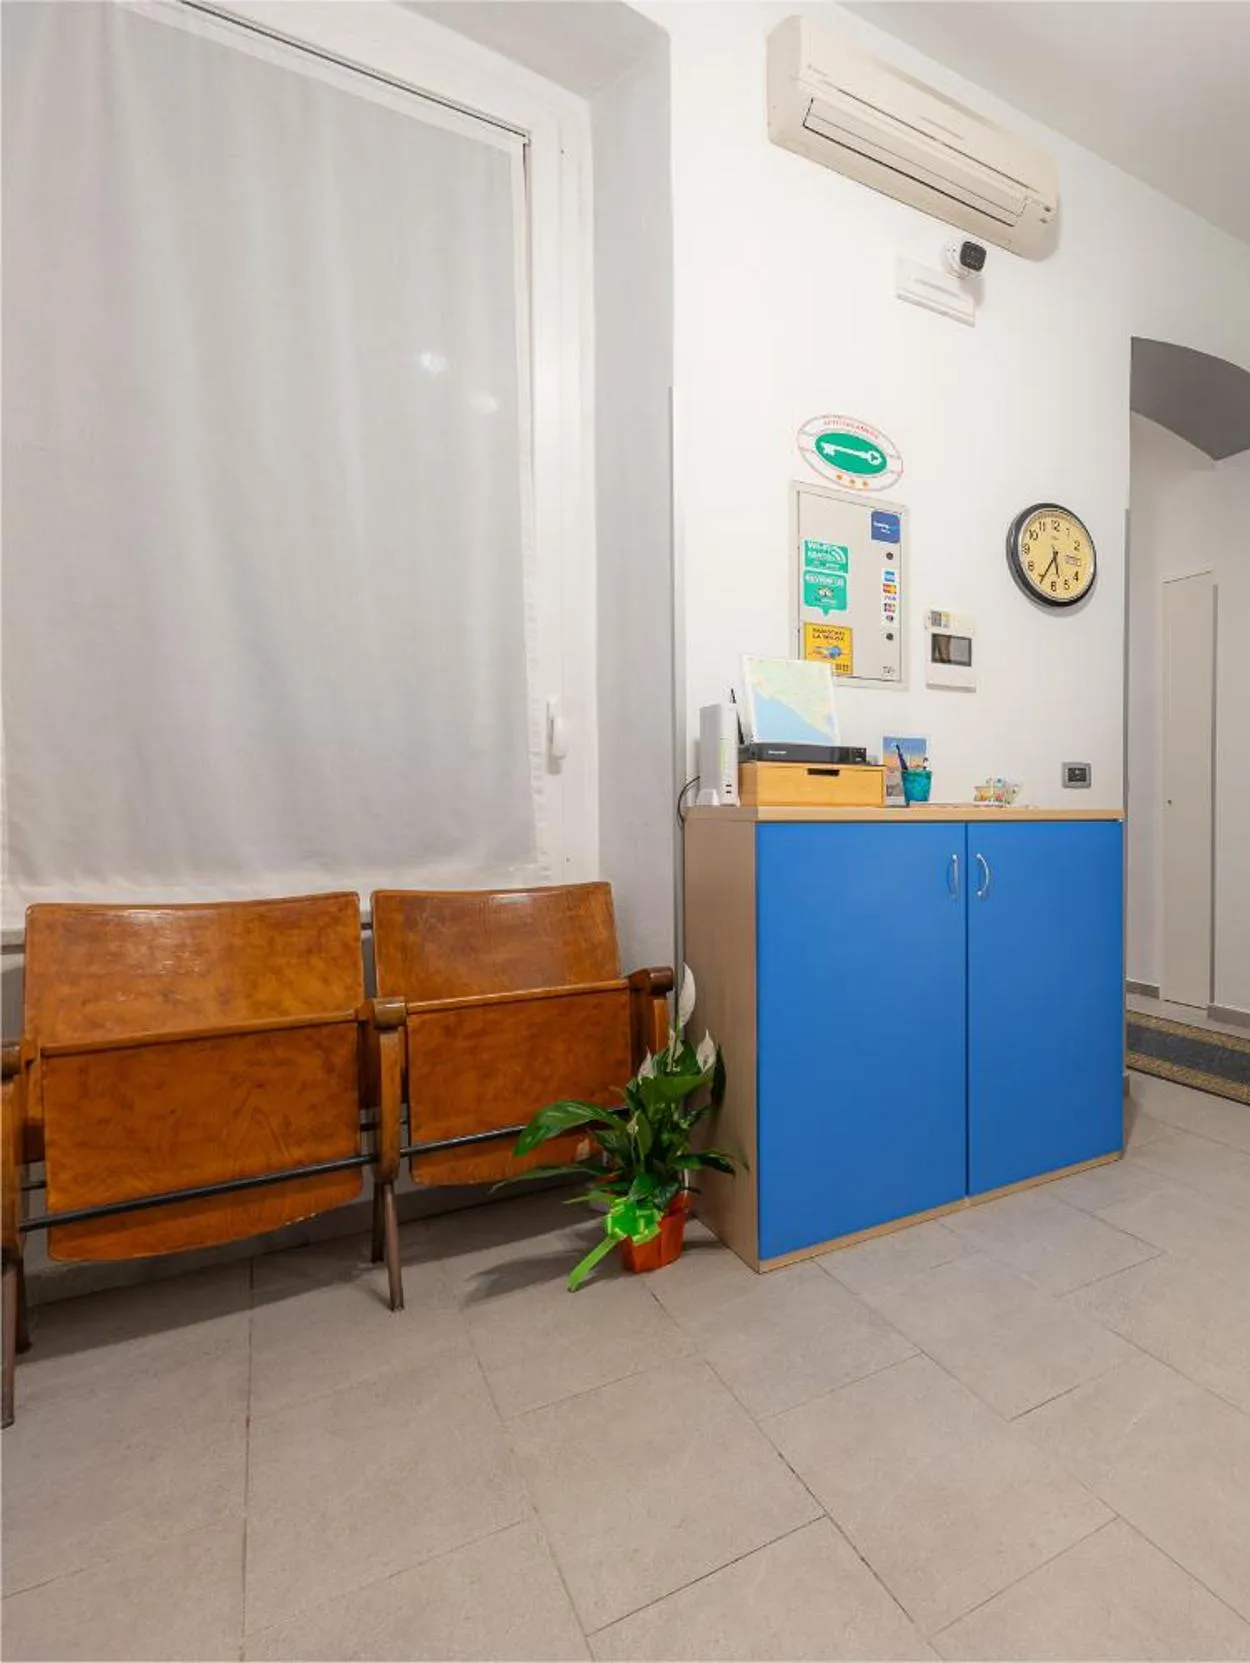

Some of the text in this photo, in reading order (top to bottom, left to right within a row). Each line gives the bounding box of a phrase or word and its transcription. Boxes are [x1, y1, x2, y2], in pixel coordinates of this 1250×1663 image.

[1039, 521, 1046, 532] 11
[1051, 519, 1060, 532] 12
[1029, 529, 1038, 541] 10
[1073, 540, 1080, 552] 2
[1027, 560, 1034, 572] 8
[1073, 571, 1079, 582] 4
[1050, 581, 1057, 592] 6
[1063, 579, 1070, 590] 5
